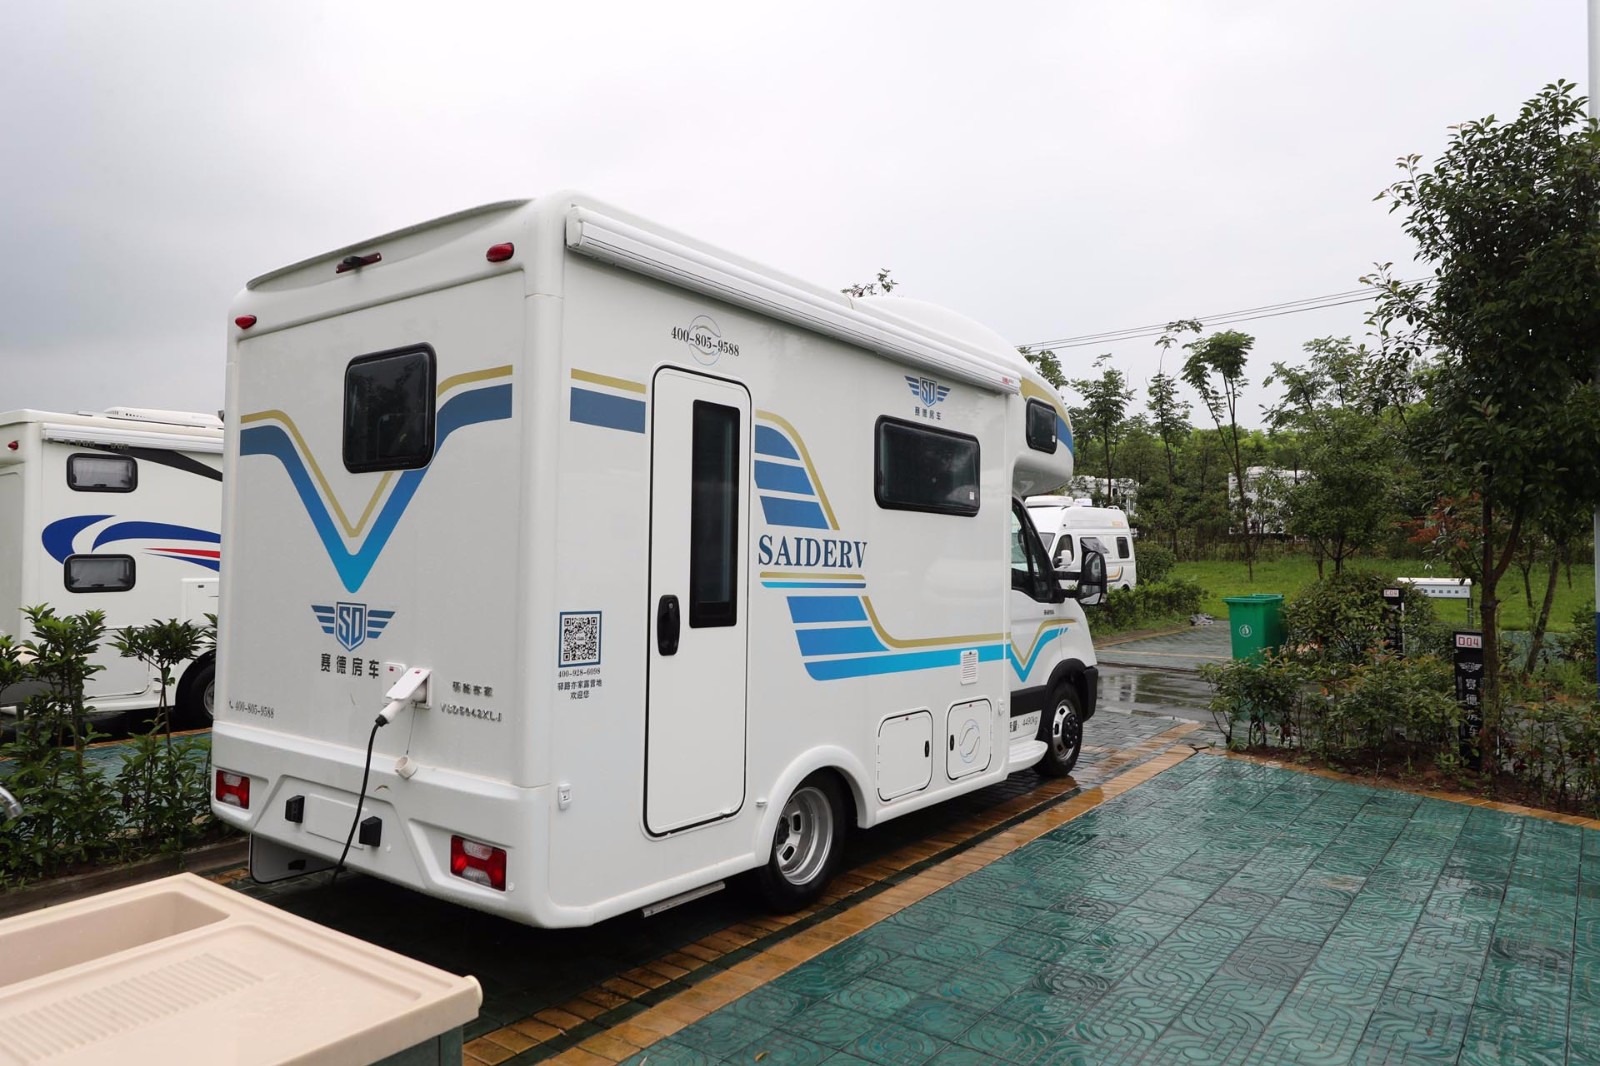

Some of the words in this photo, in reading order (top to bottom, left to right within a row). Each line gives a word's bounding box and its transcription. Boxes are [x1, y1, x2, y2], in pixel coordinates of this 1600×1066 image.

[671, 326, 740, 356] 400-805-9588
[758, 534, 868, 569] SAIDERV
[1458, 636, 1479, 647] D04
[320, 653, 380, 679] 赛德房车
